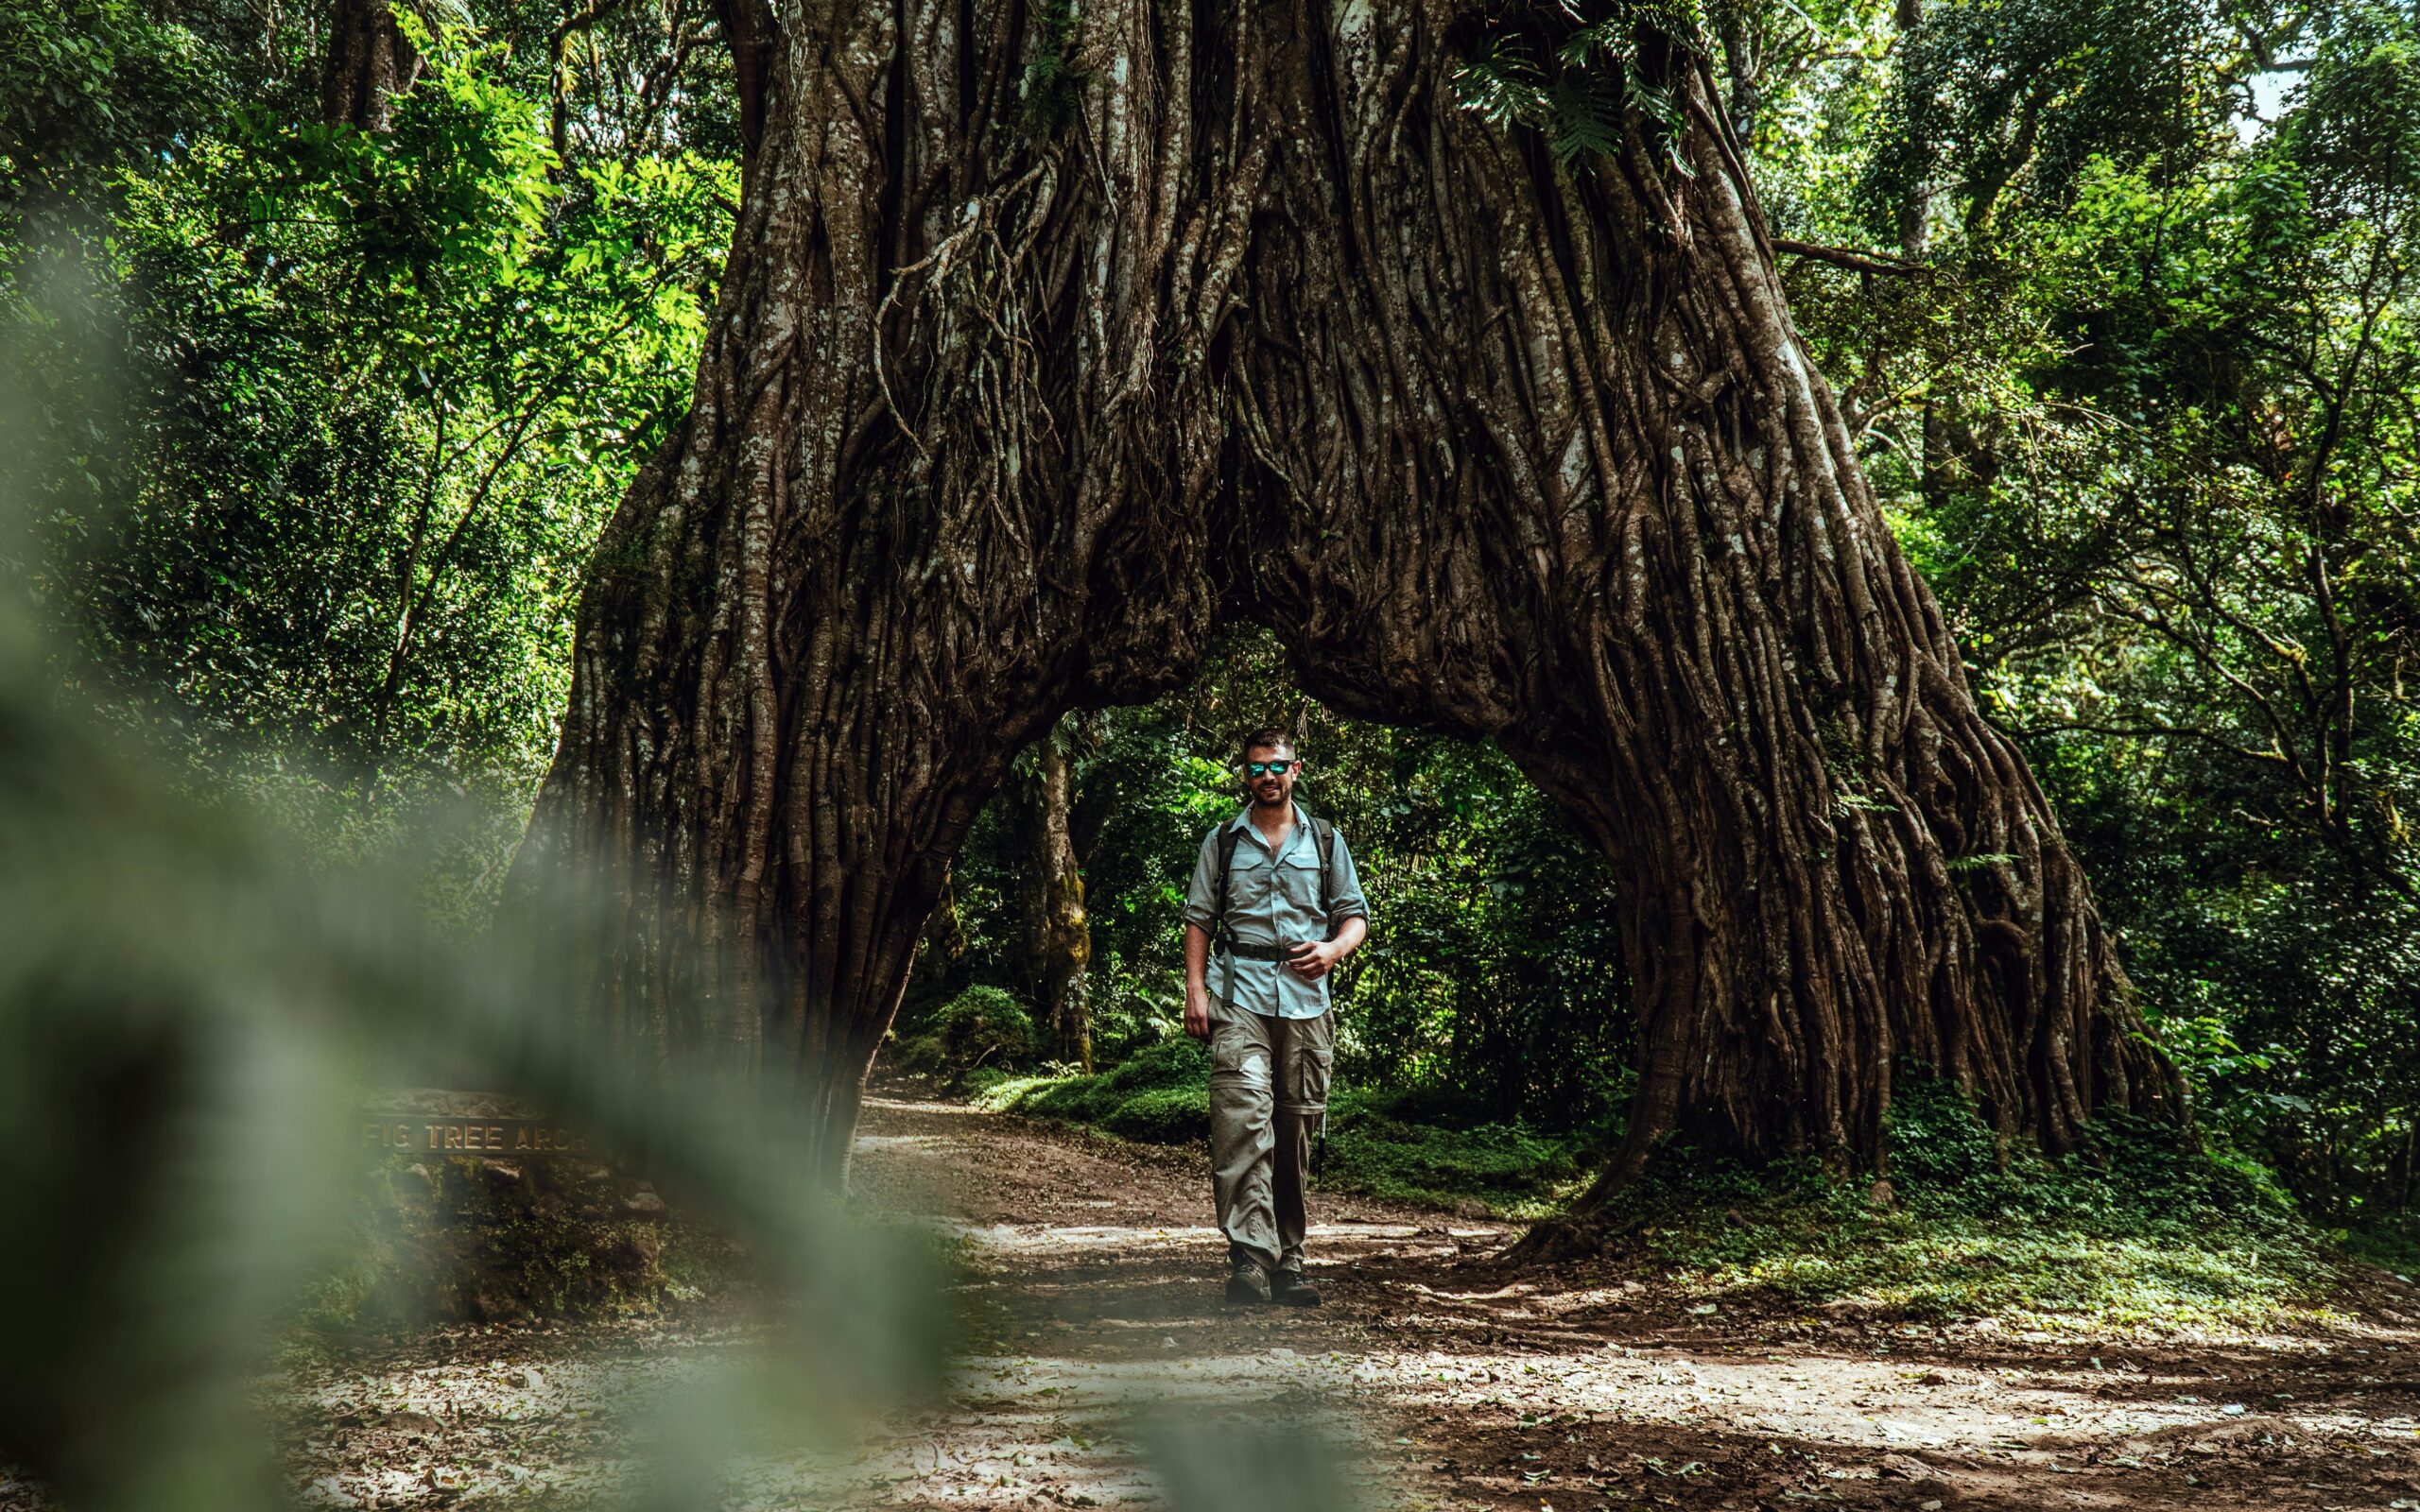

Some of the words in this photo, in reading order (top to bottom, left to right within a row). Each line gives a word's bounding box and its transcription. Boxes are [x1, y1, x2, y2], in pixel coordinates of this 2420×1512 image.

[361, 1124, 411, 1148] FIG
[424, 1125, 503, 1150] TREE
[515, 1125, 588, 1150] ARCH
